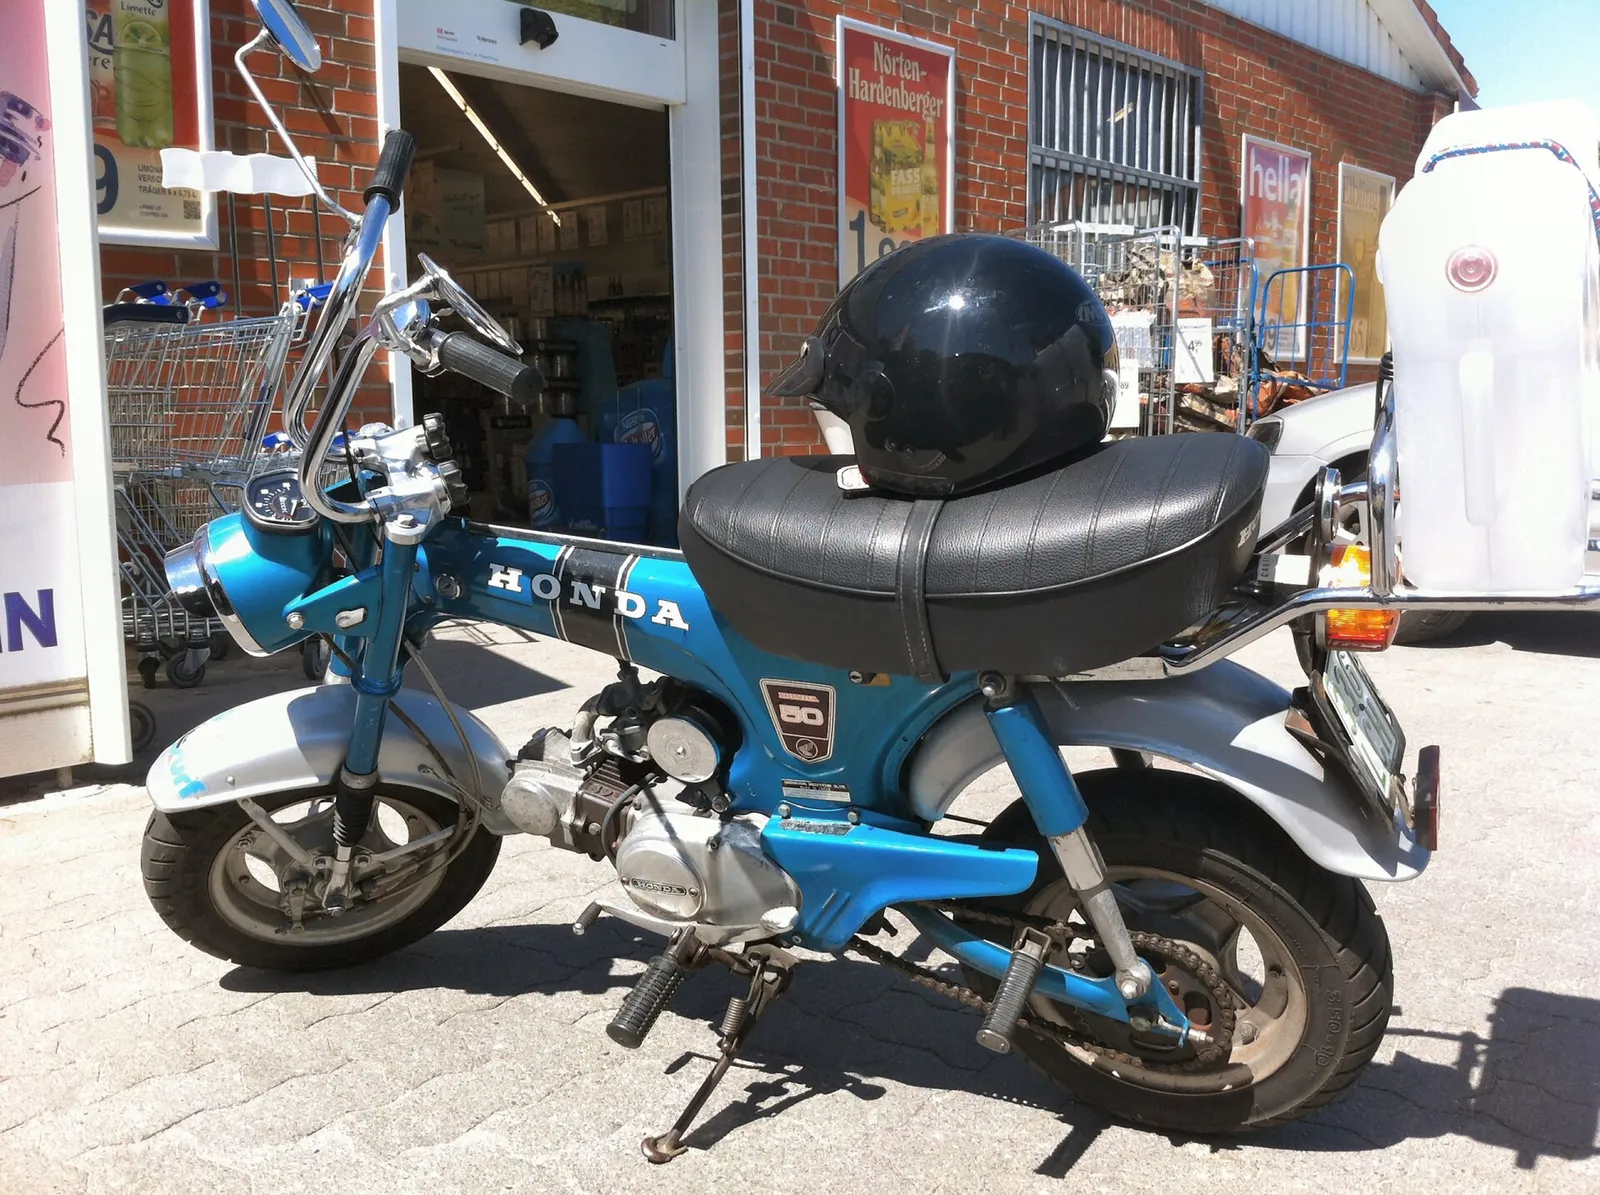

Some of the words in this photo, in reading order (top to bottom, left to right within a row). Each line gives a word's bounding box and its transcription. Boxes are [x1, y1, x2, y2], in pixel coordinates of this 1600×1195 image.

[121, 0, 157, 16] Limette
[873, 40, 927, 83] Nörten-
[848, 67, 944, 119] Hardenberger
[487, 562, 690, 632] HONDA
[0, 588, 58, 654] N
[779, 703, 825, 726] 50
[637, 880, 681, 894] HONDA
